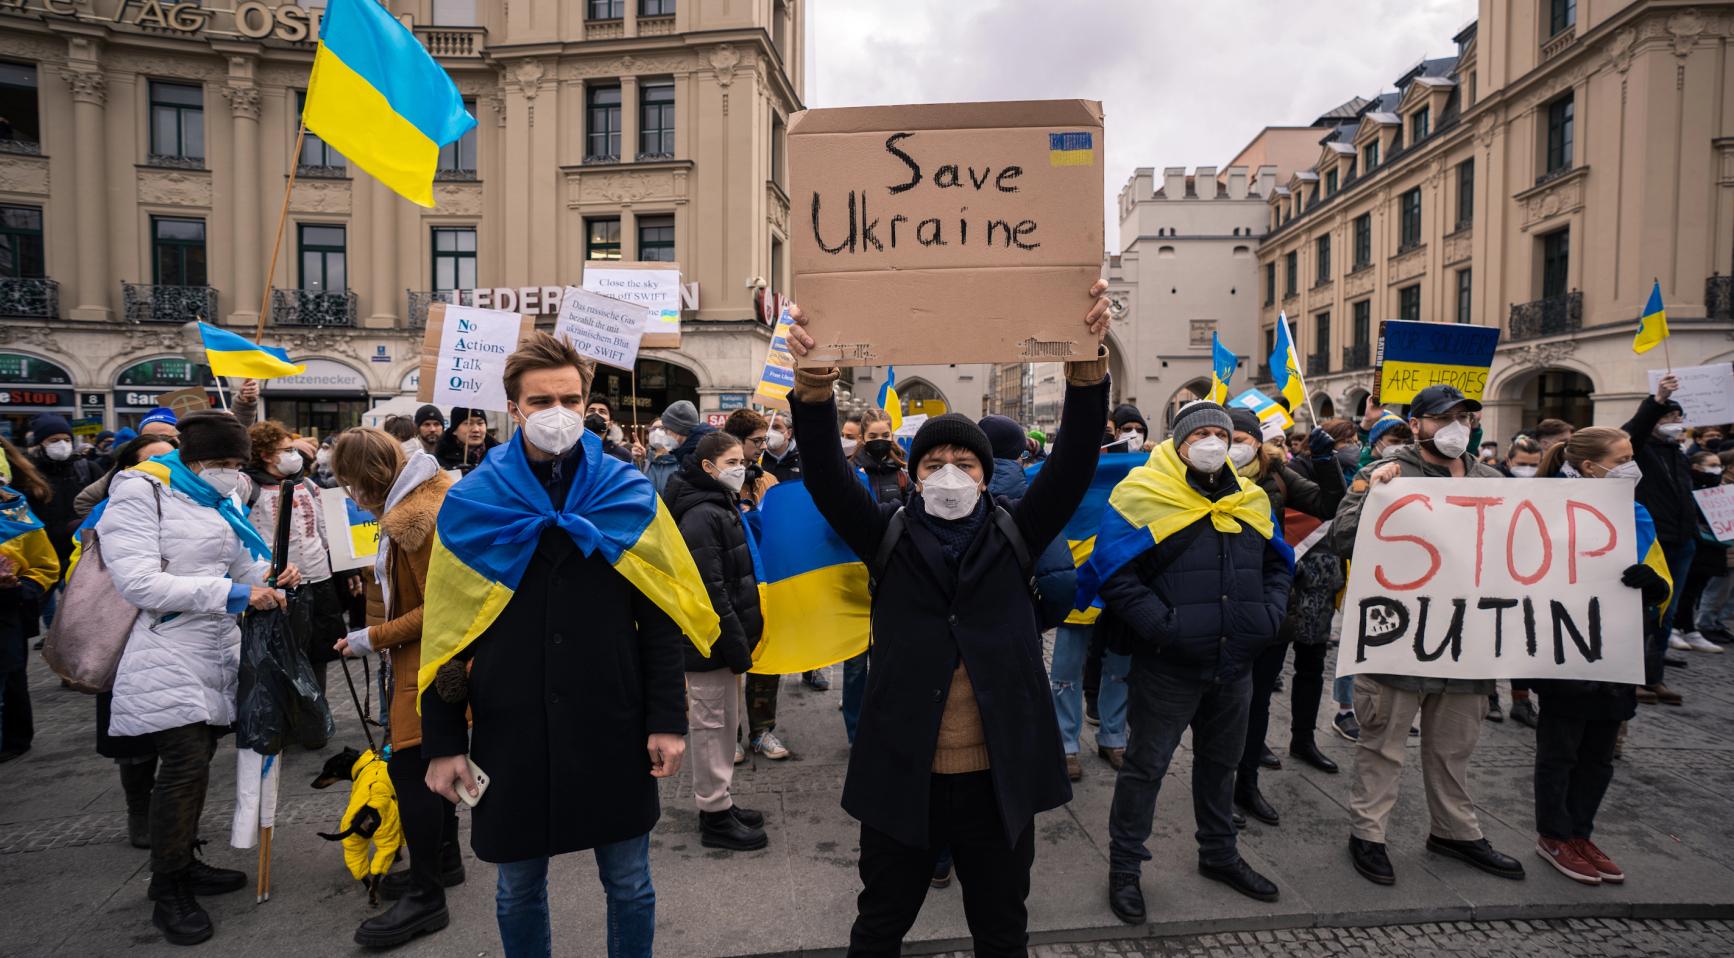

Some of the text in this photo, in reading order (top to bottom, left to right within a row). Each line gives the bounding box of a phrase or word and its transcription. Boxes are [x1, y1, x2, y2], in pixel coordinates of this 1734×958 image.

[885, 131, 1023, 195] Save
[811, 189, 1041, 255] Ukraine
[599, 278, 659, 290] Close the sky
[633, 292, 668, 301] SWIFT
[568, 312, 594, 327] bezahlt
[572, 301, 636, 326] Das russische Gas
[457, 318, 477, 334] No
[566, 324, 629, 349] ukrainischem Blut
[455, 338, 505, 353] Actions
[1376, 336, 1385, 366] SATURN
[594, 346, 625, 362] SWIFT
[452, 356, 483, 372] Talk
[278, 374, 357, 386] Hetzenecker
[448, 375, 483, 392] Only
[1387, 369, 1487, 394] ARE HEROES
[88, 394, 98, 405] 8
[709, 415, 729, 426] SA
[1374, 493, 1617, 591] STOP
[1355, 596, 1603, 664] PUTIN
